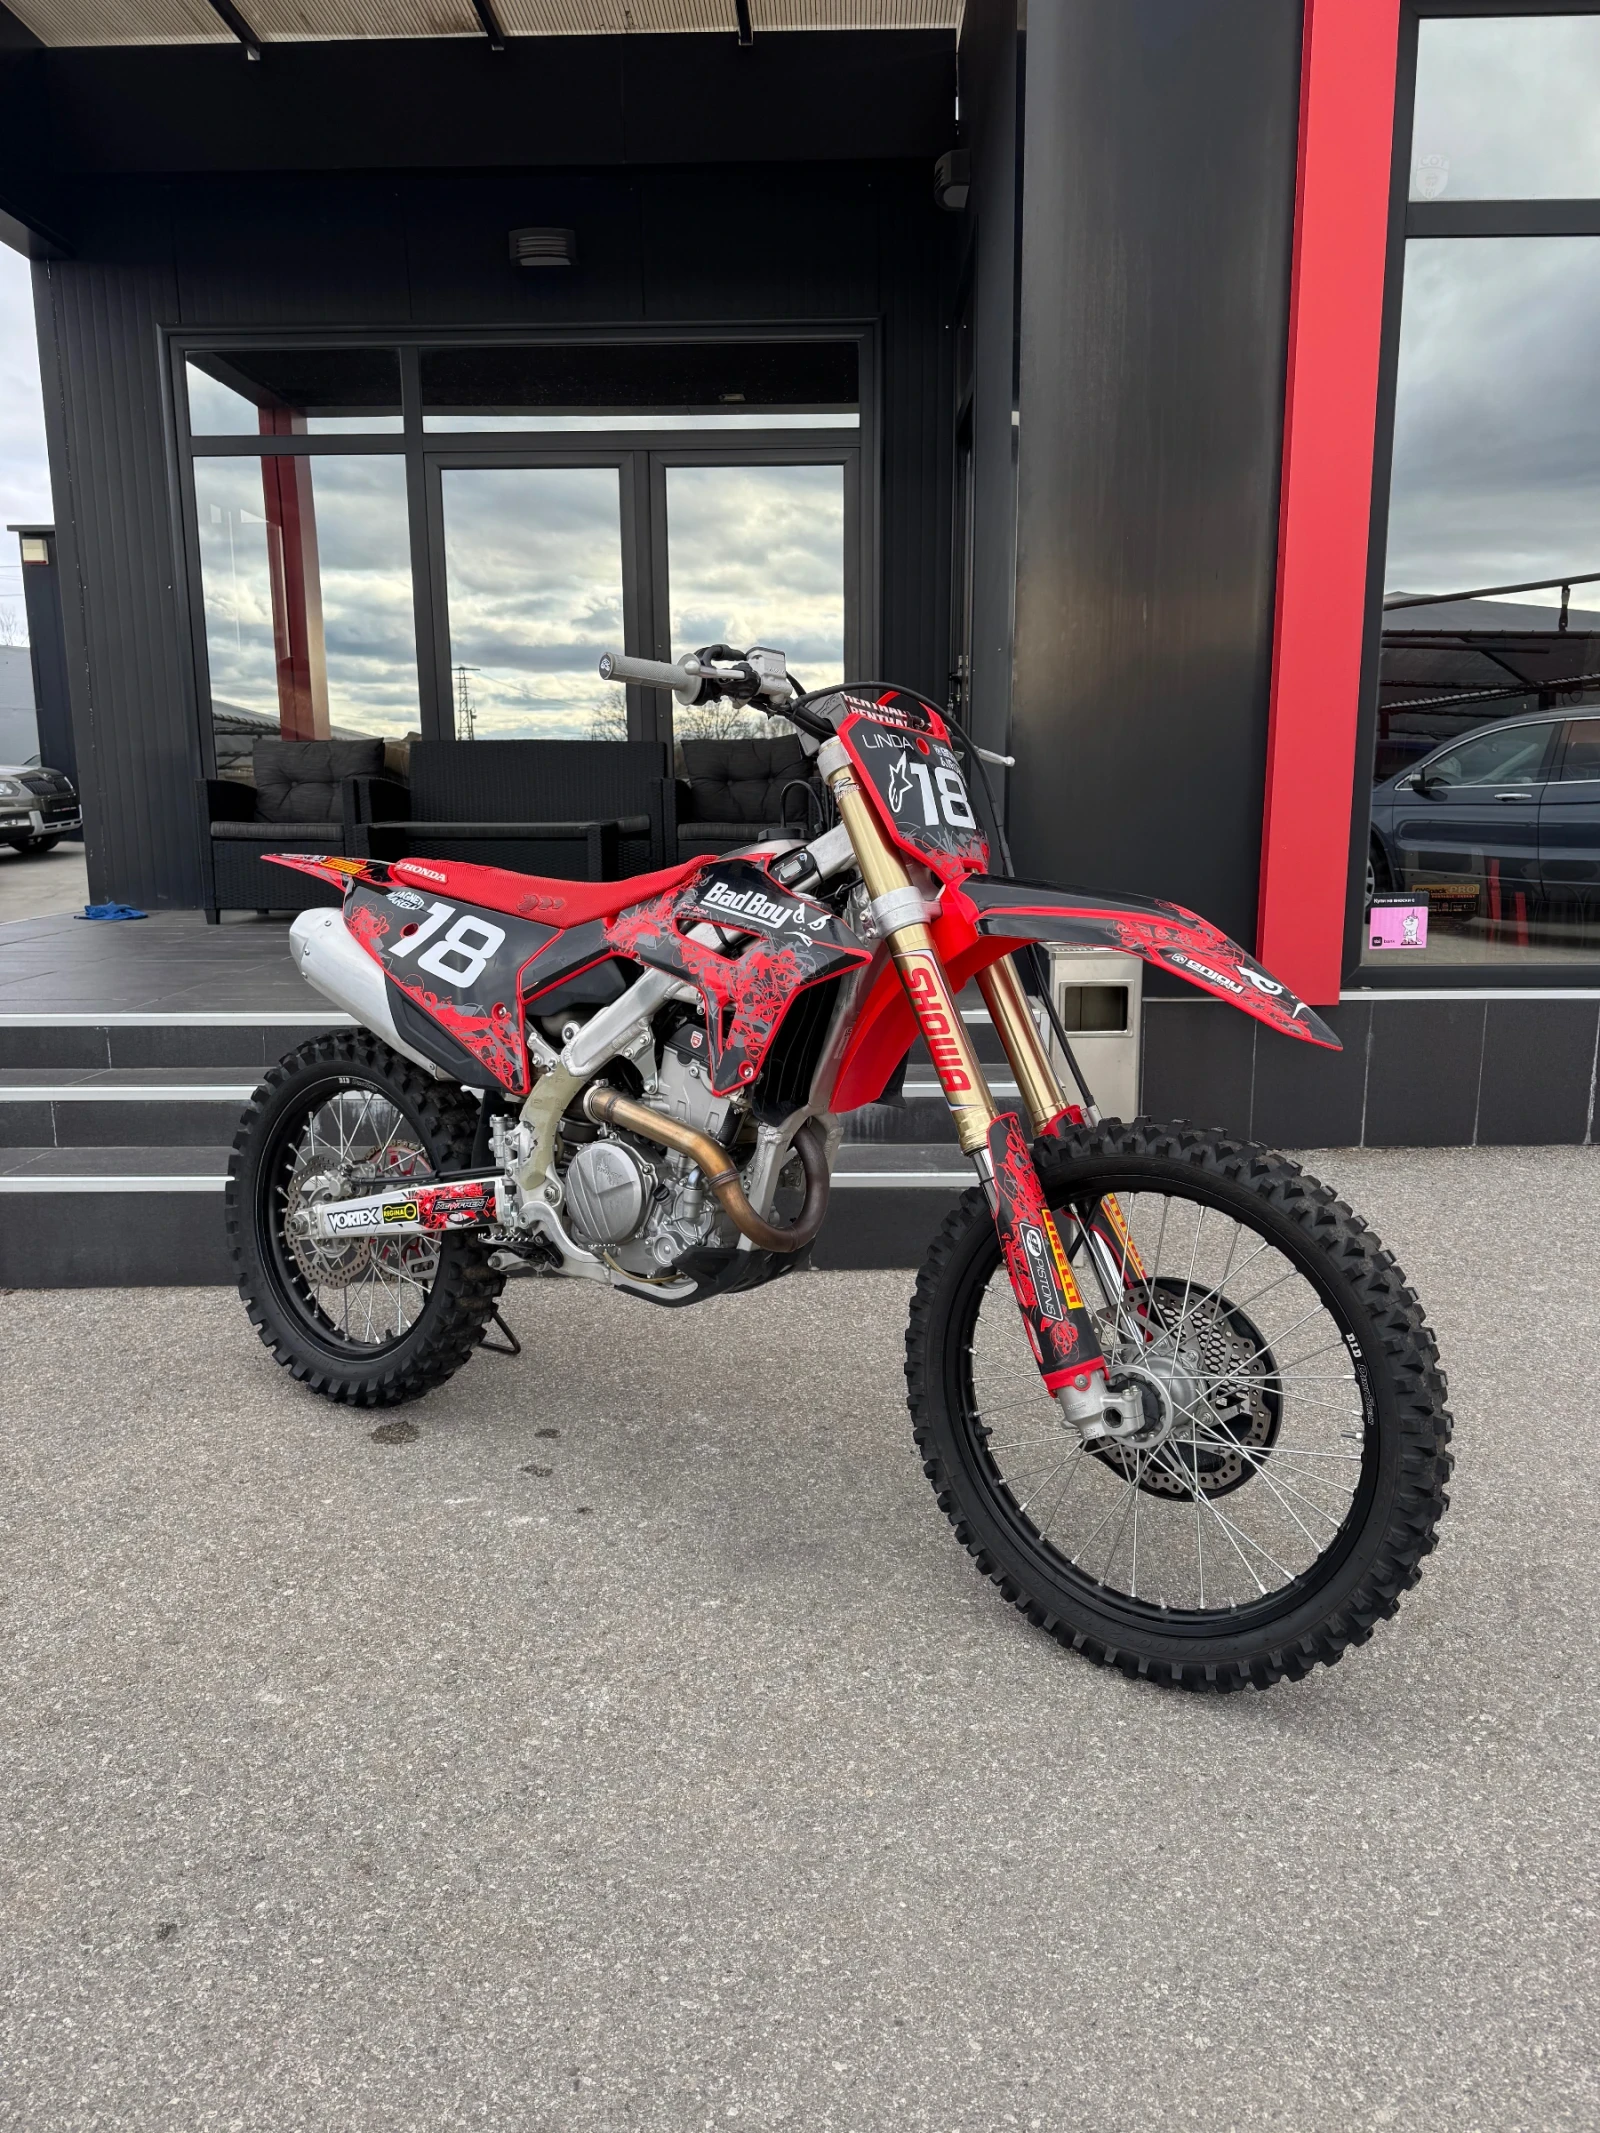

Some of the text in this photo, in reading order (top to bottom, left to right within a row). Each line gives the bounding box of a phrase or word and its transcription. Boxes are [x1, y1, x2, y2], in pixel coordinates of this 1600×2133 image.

[862, 734, 914, 750] LINDA
[909, 762, 976, 829] 18
[402, 864, 446, 882] HONDA
[1450, 885, 1475, 893] PRO
[388, 902, 506, 988] 18
[902, 967, 971, 1092] SHOWA
[328, 1207, 380, 1234] VORTEX
[383, 1208, 405, 1217] REGINA
[1034, 1256, 1056, 1316] PISTONS
